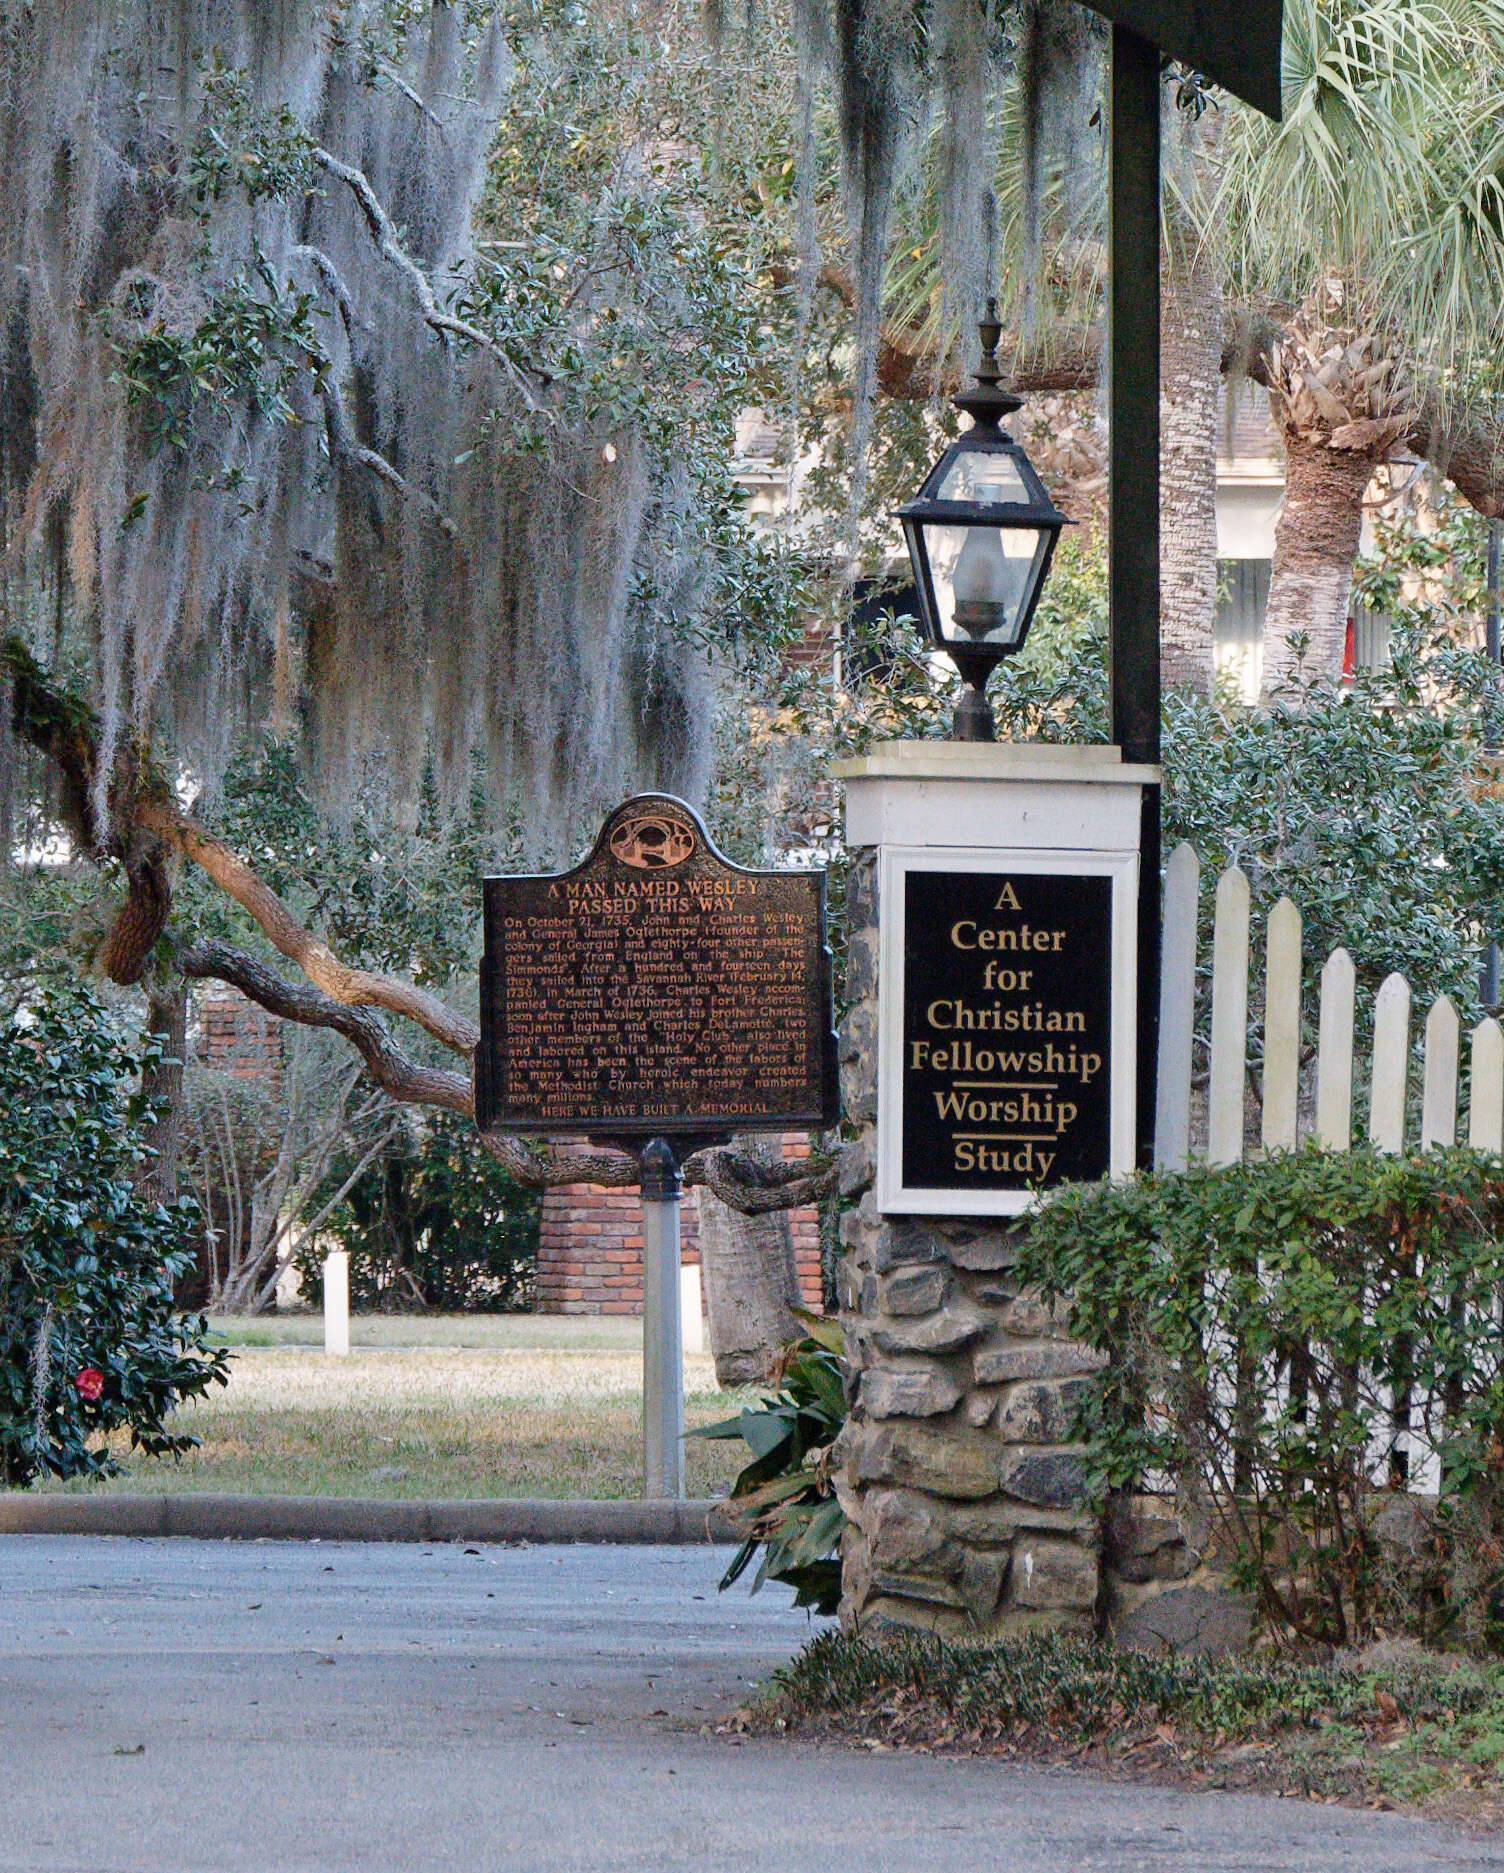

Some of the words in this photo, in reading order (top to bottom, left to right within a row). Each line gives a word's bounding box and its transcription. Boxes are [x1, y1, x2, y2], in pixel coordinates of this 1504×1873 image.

[548, 884, 559, 898] A
[567, 883, 606, 898] MAN
[614, 882, 680, 897] NAMED
[686, 881, 759, 896] WESLEY
[995, 882, 1022, 911] A
[569, 899, 637, 914] PASSED
[646, 898, 690, 913] THIS
[699, 898, 736, 912] WAY
[505, 917, 521, 928] On
[528, 916, 574, 927] October
[642, 914, 669, 925] John
[679, 914, 700, 925] and
[710, 913, 755, 924] Charles
[764, 912, 803, 925] Wesley
[505, 928, 526, 939] and
[532, 927, 577, 938] General
[584, 927, 619, 938] James
[626, 925, 697, 939] Oglethorpe
[766, 924, 777, 935] of
[786, 924, 804, 934] the
[951, 921, 1066, 951] Center
[505, 939, 542, 953] colony
[549, 939, 560, 950] of
[625, 938, 646, 948] and
[652, 936, 720, 950] eighty-four
[726, 936, 757, 947] other
[506, 953, 532, 964] gers
[543, 951, 576, 962] sailed
[586, 950, 614, 961] from
[625, 949, 673, 963] England
[684, 951, 697, 959] on
[711, 948, 729, 959] the
[581, 962, 611, 973] After
[618, 964, 626, 973] a
[635, 961, 683, 972] hundred
[692, 961, 712, 972] and
[722, 960, 770, 971] fourteen
[778, 959, 805, 972] days
[507, 974, 533, 987] they
[542, 974, 574, 985] sailed
[611, 973, 628, 984] the
[636, 972, 691, 983] Savannah
[696, 971, 725, 982] River
[984, 961, 1032, 991] for
[565, 986, 601, 997] March
[608, 986, 618, 996] of
[666, 984, 710, 995] Charles
[718, 983, 757, 997] Wesley
[507, 997, 547, 1010] panied
[558, 996, 603, 1007] General
[692, 995, 703, 1006] to
[711, 994, 736, 1005] Fort
[506, 1012, 532, 1021] soon
[538, 1009, 565, 1020] after
[571, 1009, 599, 1020] John
[605, 1008, 644, 1021] Wesley
[689, 1007, 706, 1018] his
[711, 1006, 754, 1018] brother
[927, 1000, 1086, 1032] Christian
[507, 1021, 565, 1035] Benjamin
[573, 1020, 617, 1034] Ingham
[625, 1020, 646, 1031] and
[654, 1019, 700, 1030] Charles
[785, 1017, 806, 1028] two
[507, 1033, 539, 1044] other
[548, 1032, 600, 1043] members
[608, 1032, 620, 1043] of
[629, 1031, 648, 1042] the
[746, 1030, 771, 1041] also
[778, 1029, 806, 1040] lived
[509, 1045, 530, 1056] and
[539, 1044, 584, 1055] labored
[593, 1046, 606, 1055] on
[615, 1043, 637, 1054] this
[696, 1042, 710, 1053] No
[720, 1042, 750, 1053] other
[510, 1057, 560, 1068] America
[568, 1056, 588, 1067] has
[598, 1056, 626, 1067] been
[635, 1055, 654, 1066] the
[705, 1054, 717, 1065] of
[725, 1054, 742, 1065] the
[750, 1053, 786, 1064] labors
[794, 1053, 806, 1063] of
[911, 1041, 1101, 1083] Fellowship
[508, 1071, 521, 1080] so
[530, 1071, 563, 1082] many
[611, 1068, 626, 1081] by
[640, 1067, 679, 1078] heroic
[691, 1066, 749, 1077] endeavor
[759, 1065, 807, 1077] created
[510, 1081, 528, 1091] the
[538, 1080, 598, 1091] Methodist
[609, 1079, 654, 1090] Church
[663, 1078, 698, 1089] which
[709, 1078, 744, 1091] today
[755, 1077, 806, 1088] numbers
[542, 1105, 575, 1117] HERE
[579, 1104, 599, 1116] WE
[603, 1104, 637, 1116] HAVE
[644, 1103, 679, 1115] BUILT
[685, 1103, 693, 1115] A
[933, 1092, 1077, 1134] Worship
[955, 1142, 1056, 1182] Study
